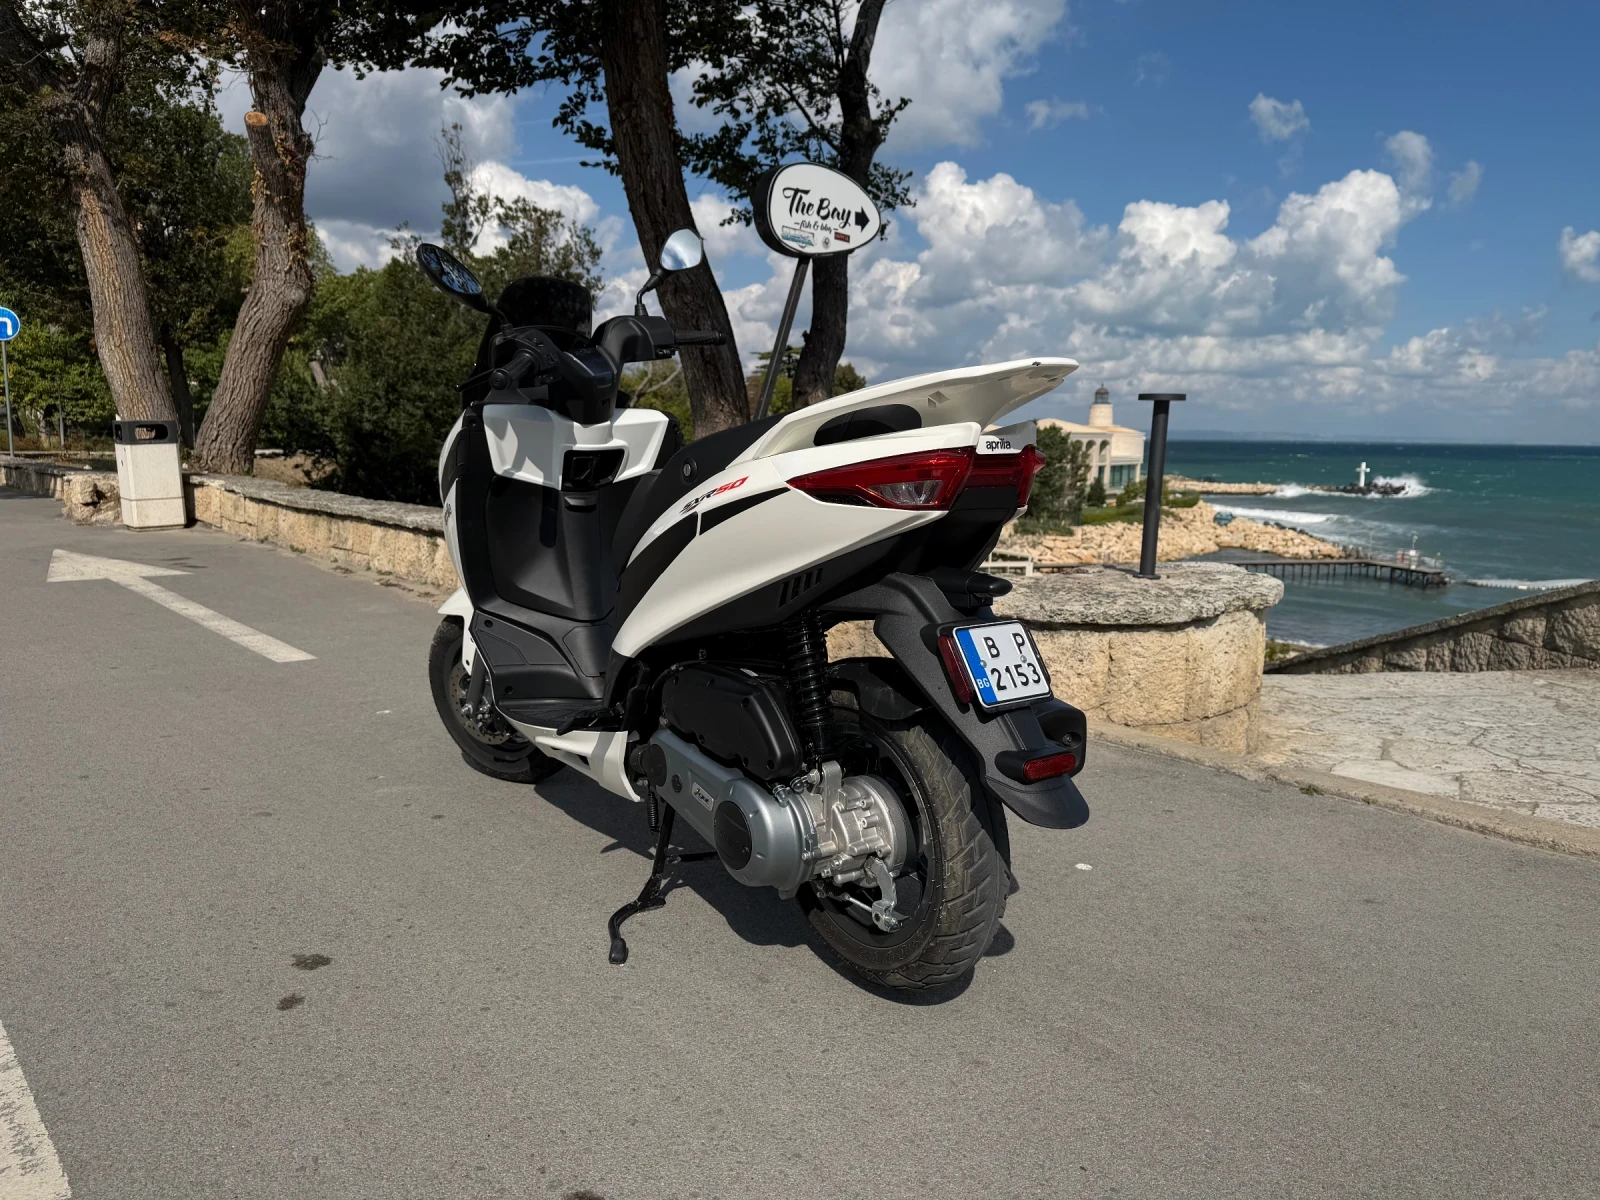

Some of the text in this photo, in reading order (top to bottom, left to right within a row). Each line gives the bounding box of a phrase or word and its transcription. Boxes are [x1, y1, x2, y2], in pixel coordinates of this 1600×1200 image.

[782, 187, 851, 229] The Bay
[985, 438, 1011, 451] aprilia
[983, 633, 1025, 658] B P
[977, 678, 990, 688] BG
[990, 662, 1040, 691] 2153
